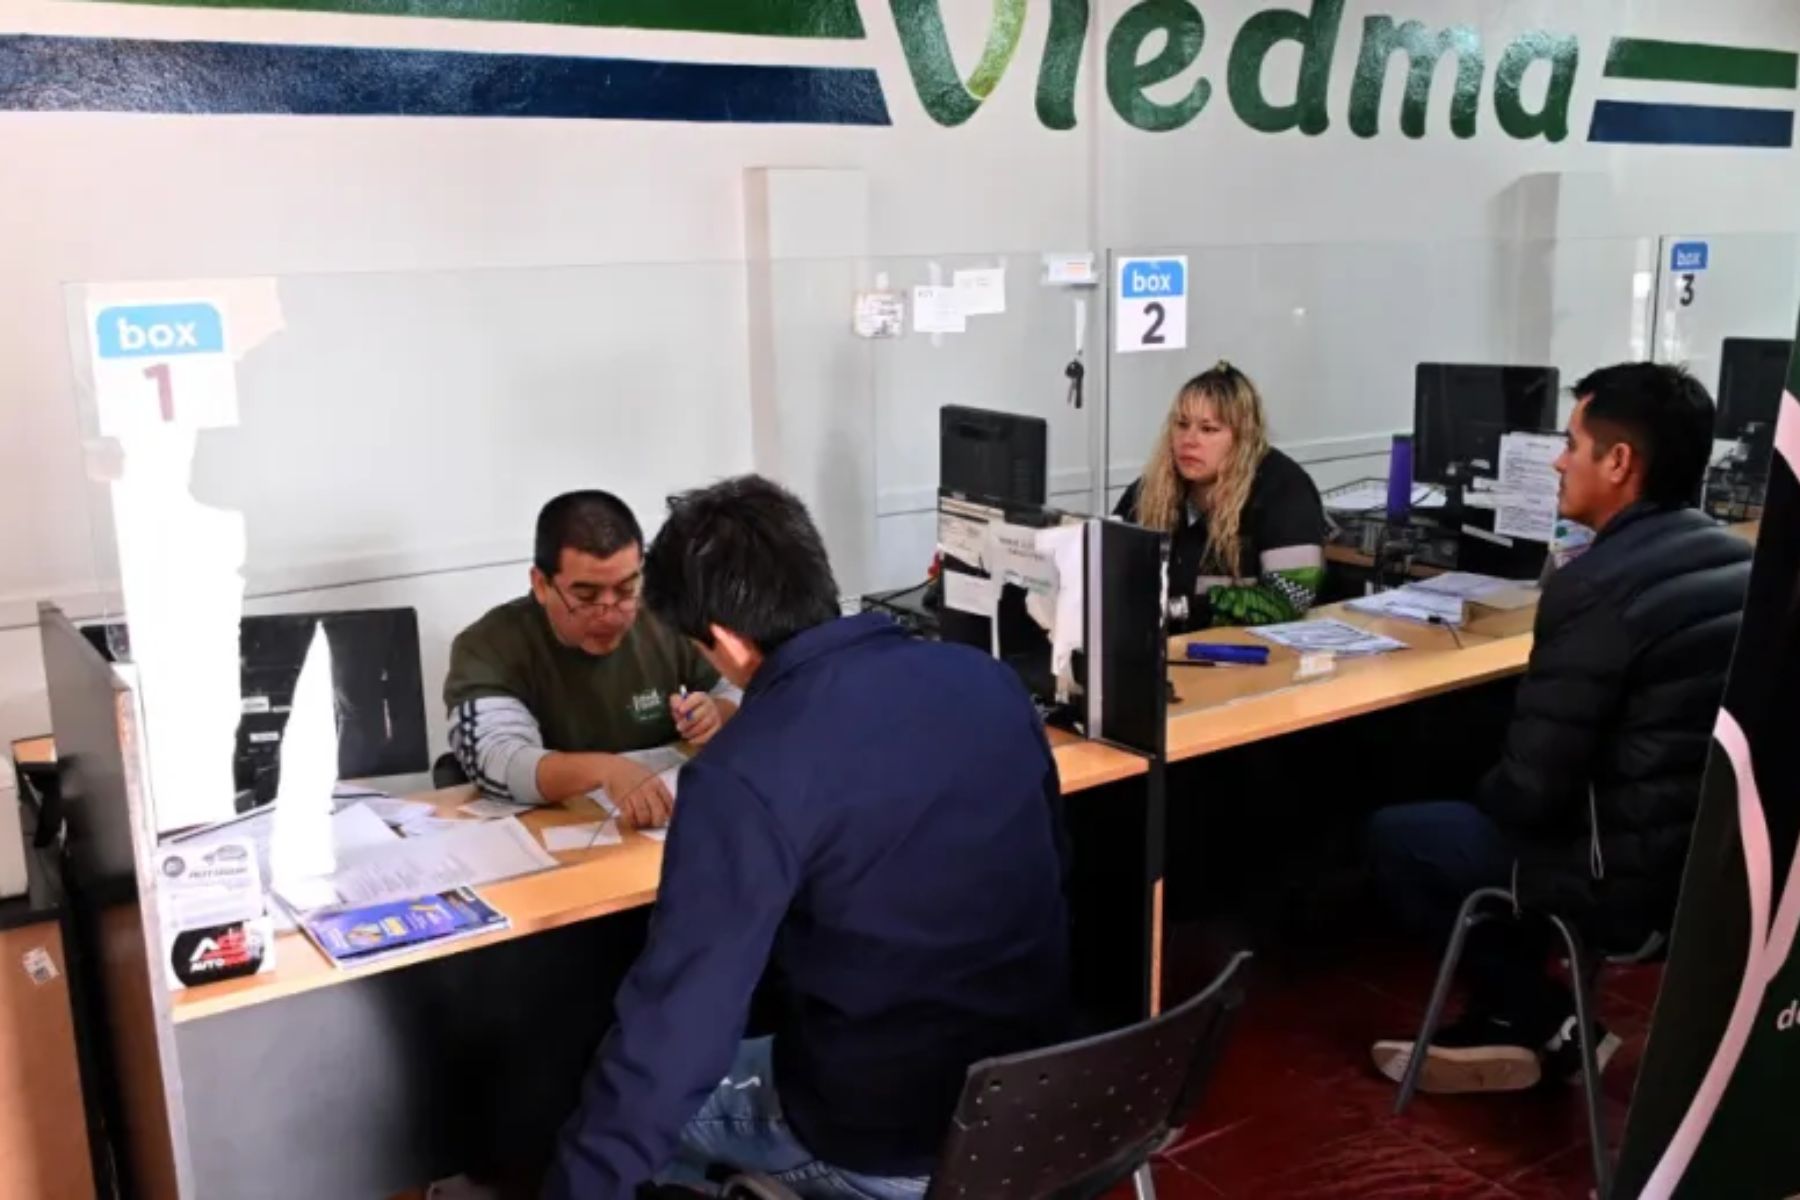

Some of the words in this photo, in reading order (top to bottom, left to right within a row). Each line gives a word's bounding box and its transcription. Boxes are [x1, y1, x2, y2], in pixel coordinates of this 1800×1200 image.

[887, 0, 1580, 143] Viedma
[1676, 248, 1702, 266] box
[1132, 270, 1171, 293] box
[1680, 273, 1695, 307] 3
[117, 316, 198, 350] box
[1141, 300, 1166, 345] 2
[143, 362, 175, 422] 1
